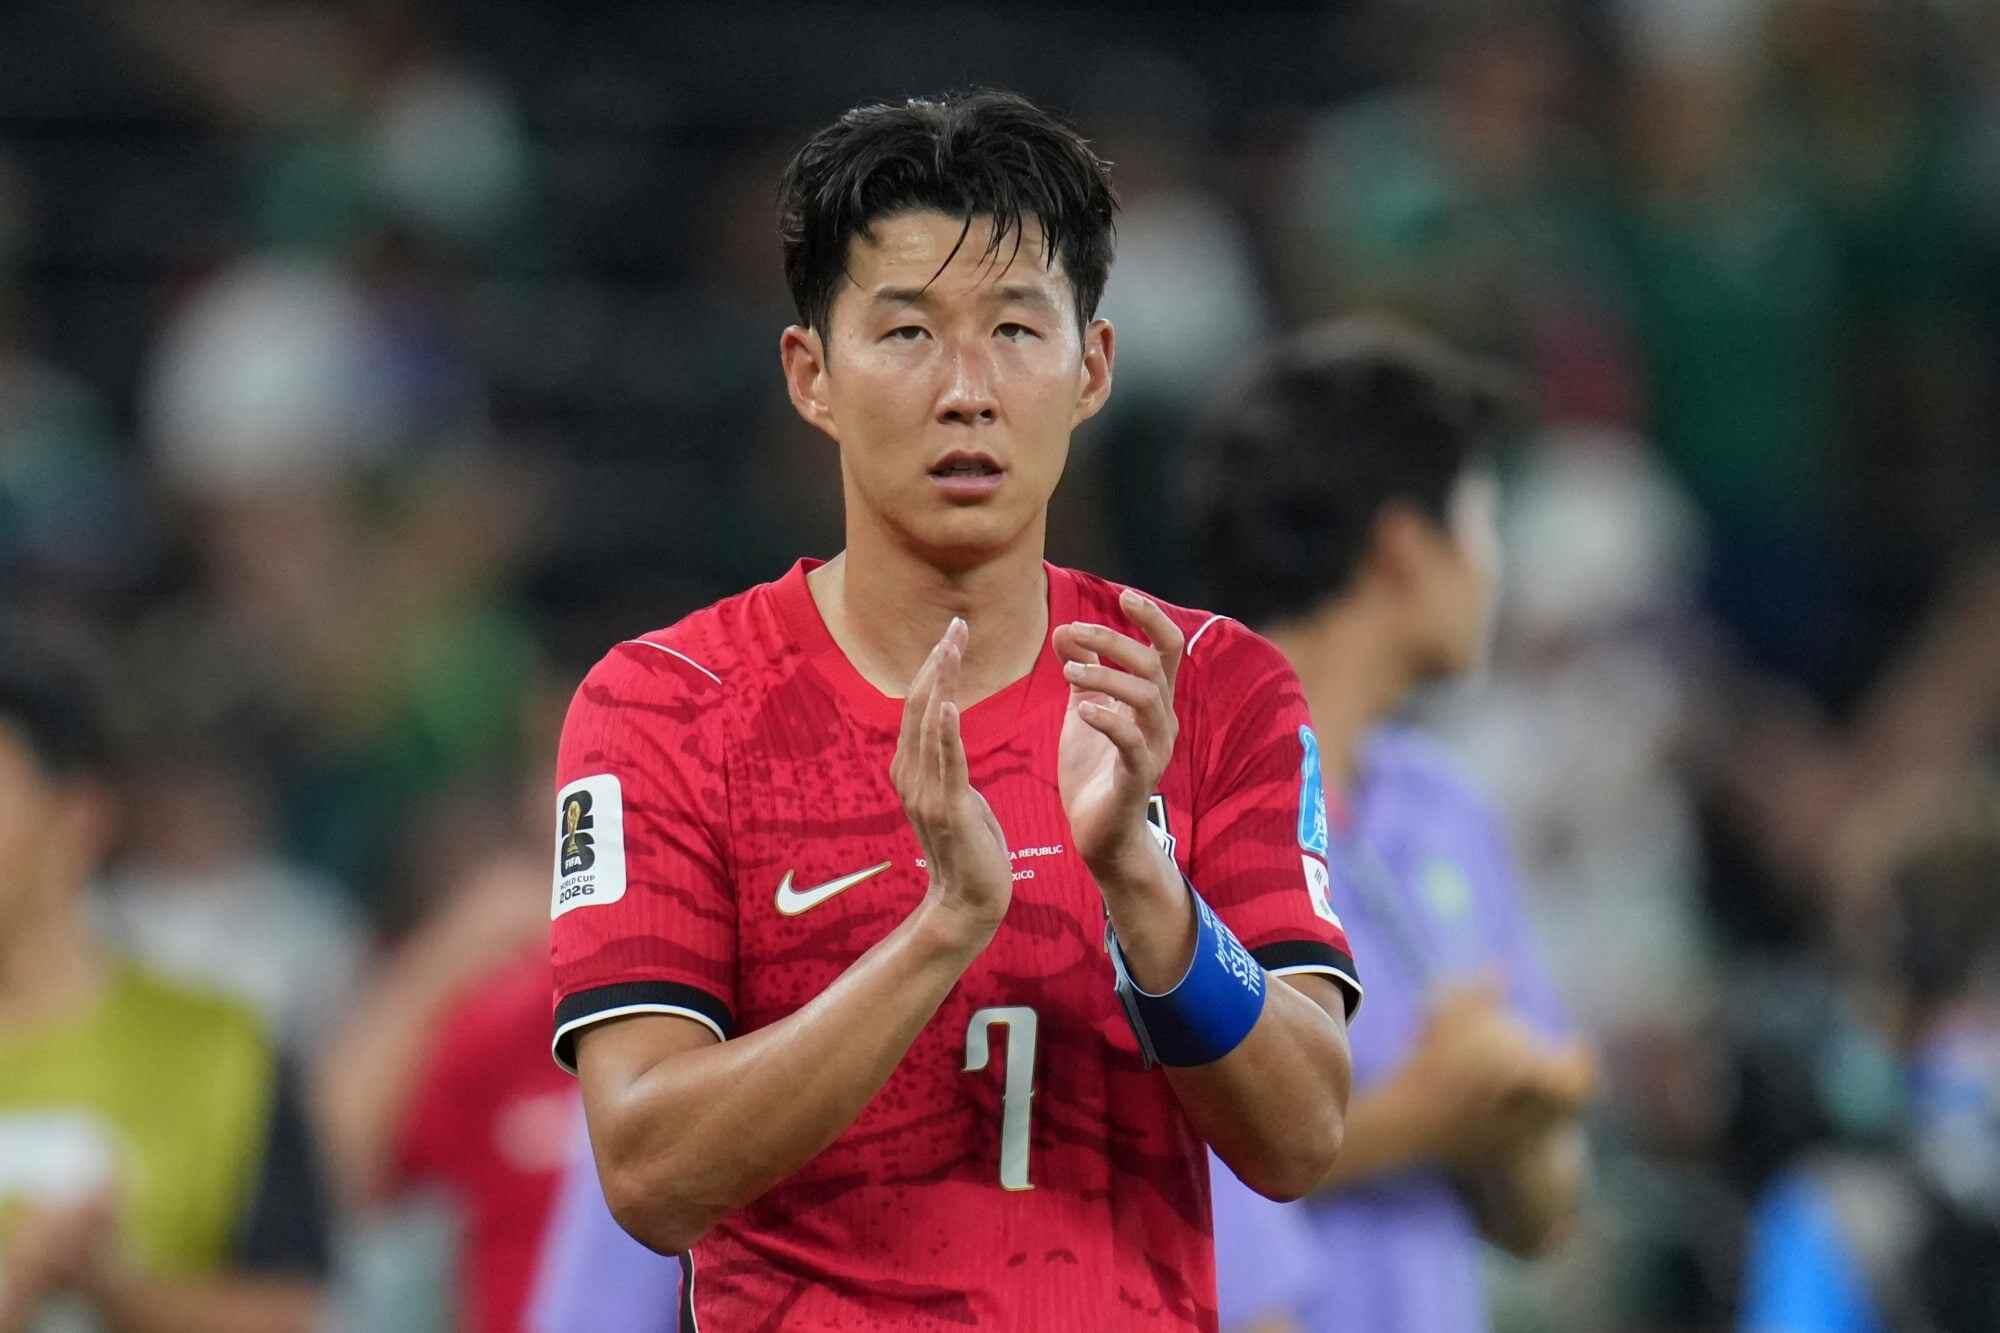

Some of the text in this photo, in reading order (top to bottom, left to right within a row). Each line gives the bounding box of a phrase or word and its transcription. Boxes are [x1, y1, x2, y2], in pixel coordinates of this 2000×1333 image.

[1018, 844, 1064, 859] REPUBLIC
[565, 856, 582, 870] FIFA
[577, 874, 596, 883] CUP
[1011, 869, 1035, 881] XICO
[559, 884, 595, 905] 2026
[962, 1006, 1037, 1191] 7
